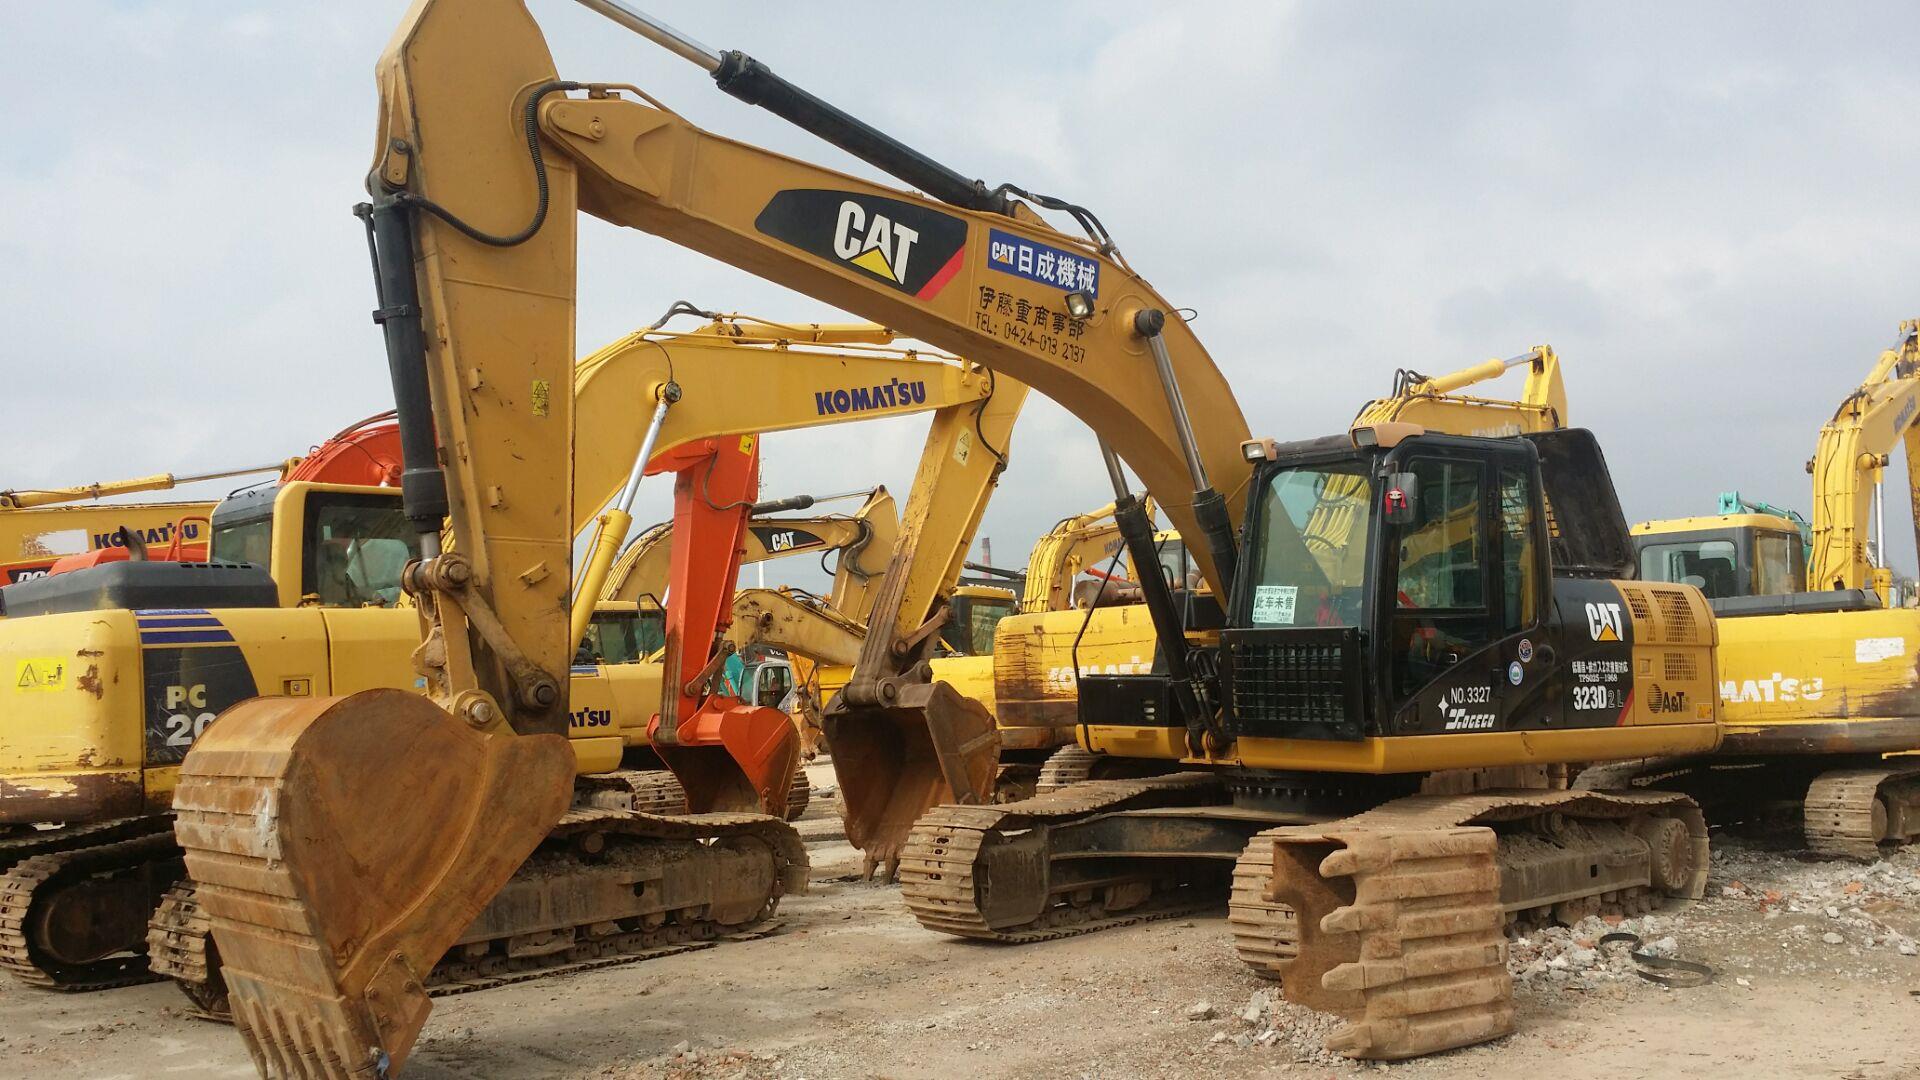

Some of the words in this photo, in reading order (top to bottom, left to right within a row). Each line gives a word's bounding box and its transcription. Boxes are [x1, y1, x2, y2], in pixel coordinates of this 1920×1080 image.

[834, 200, 919, 285] CAT
[991, 241, 1016, 265] CAT
[1018, 244, 1096, 294] 日成機械
[815, 377, 926, 415] KOMATSU
[771, 531, 795, 551] CAT
[1585, 602, 1624, 641] CAT
[166, 684, 206, 710] PC
[1450, 686, 1491, 704] NO.3327
